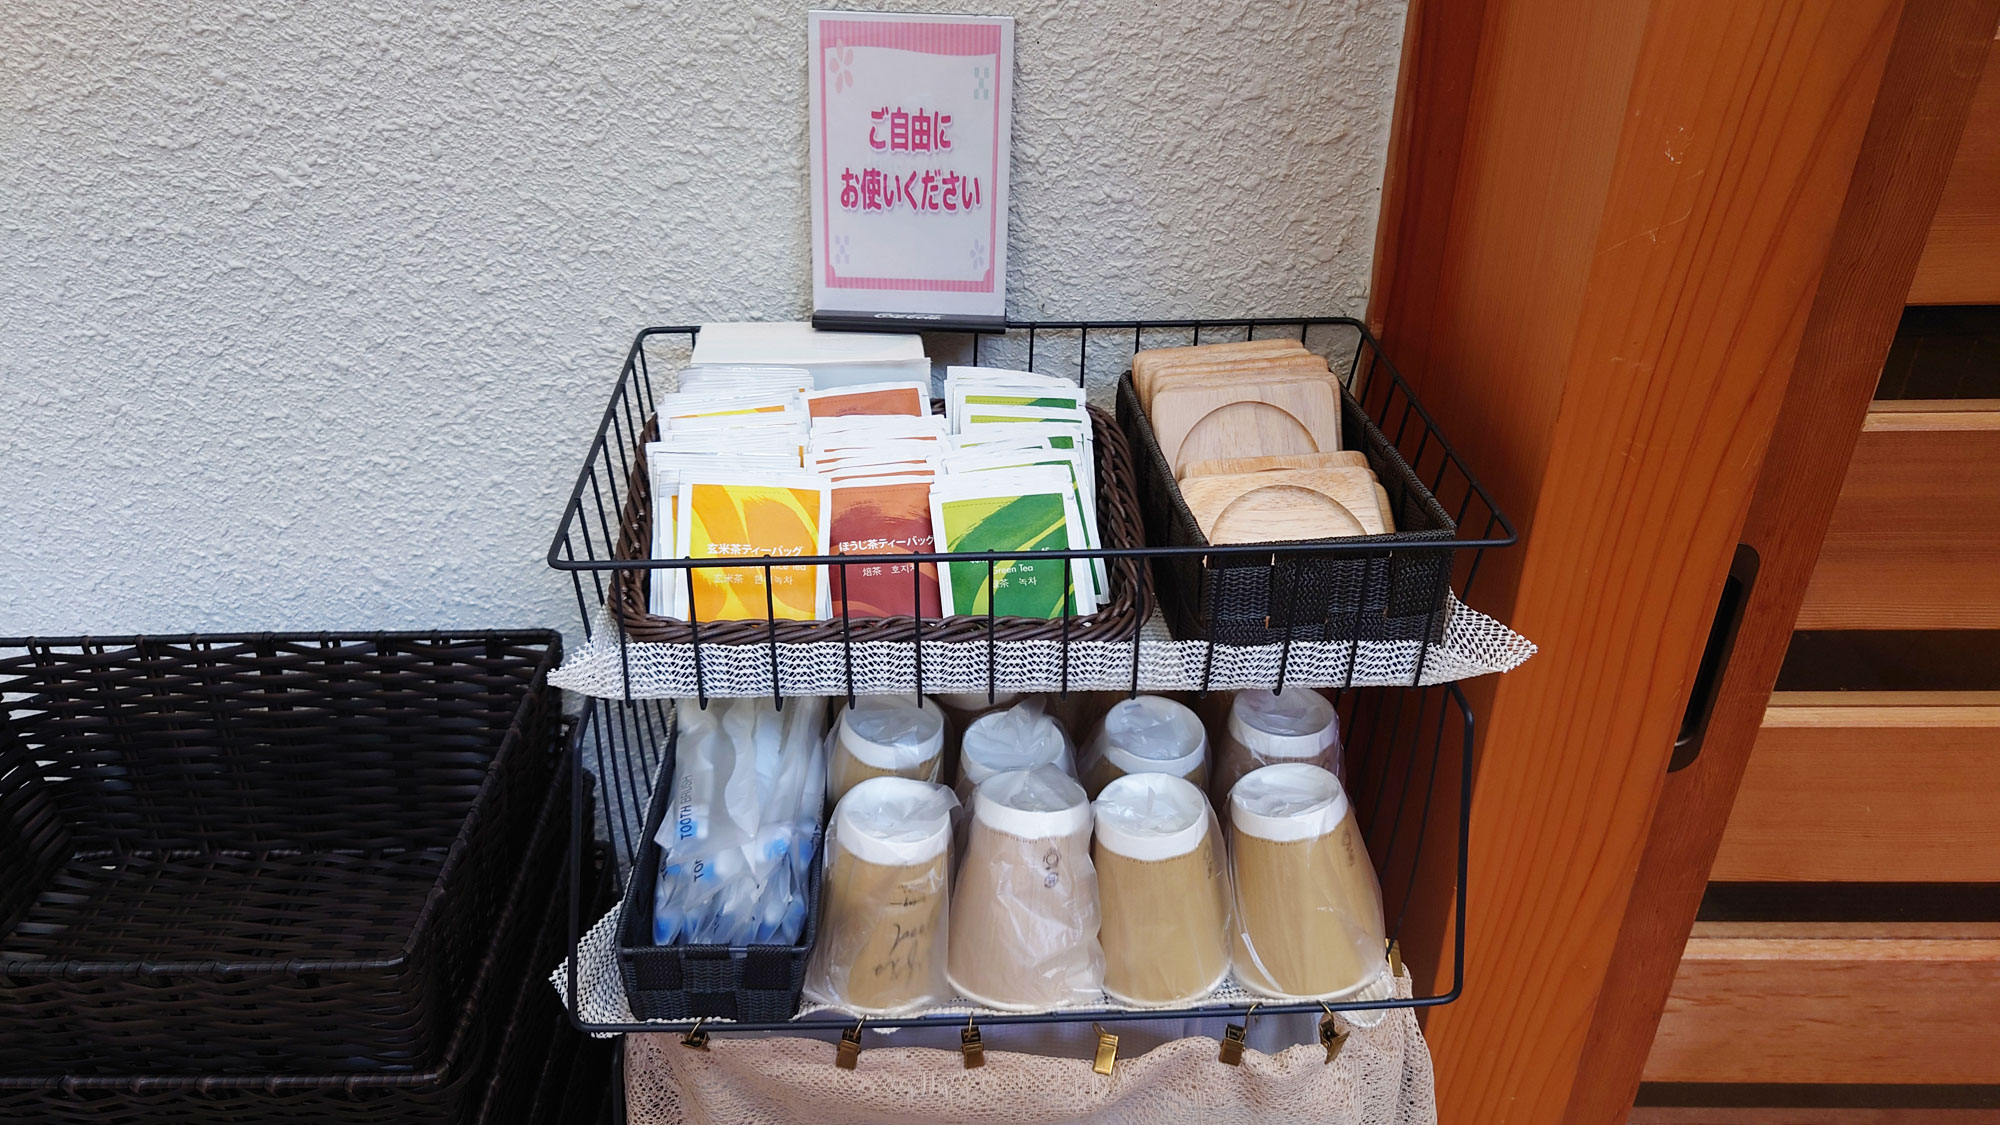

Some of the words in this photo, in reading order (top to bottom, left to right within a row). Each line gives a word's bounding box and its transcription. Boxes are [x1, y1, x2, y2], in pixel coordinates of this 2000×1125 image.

[869, 106, 952, 152] ご自由に
[840, 167, 981, 211] お使いください
[1018, 564, 1034, 573] Tea
[680, 805, 692, 840] TOOTH
